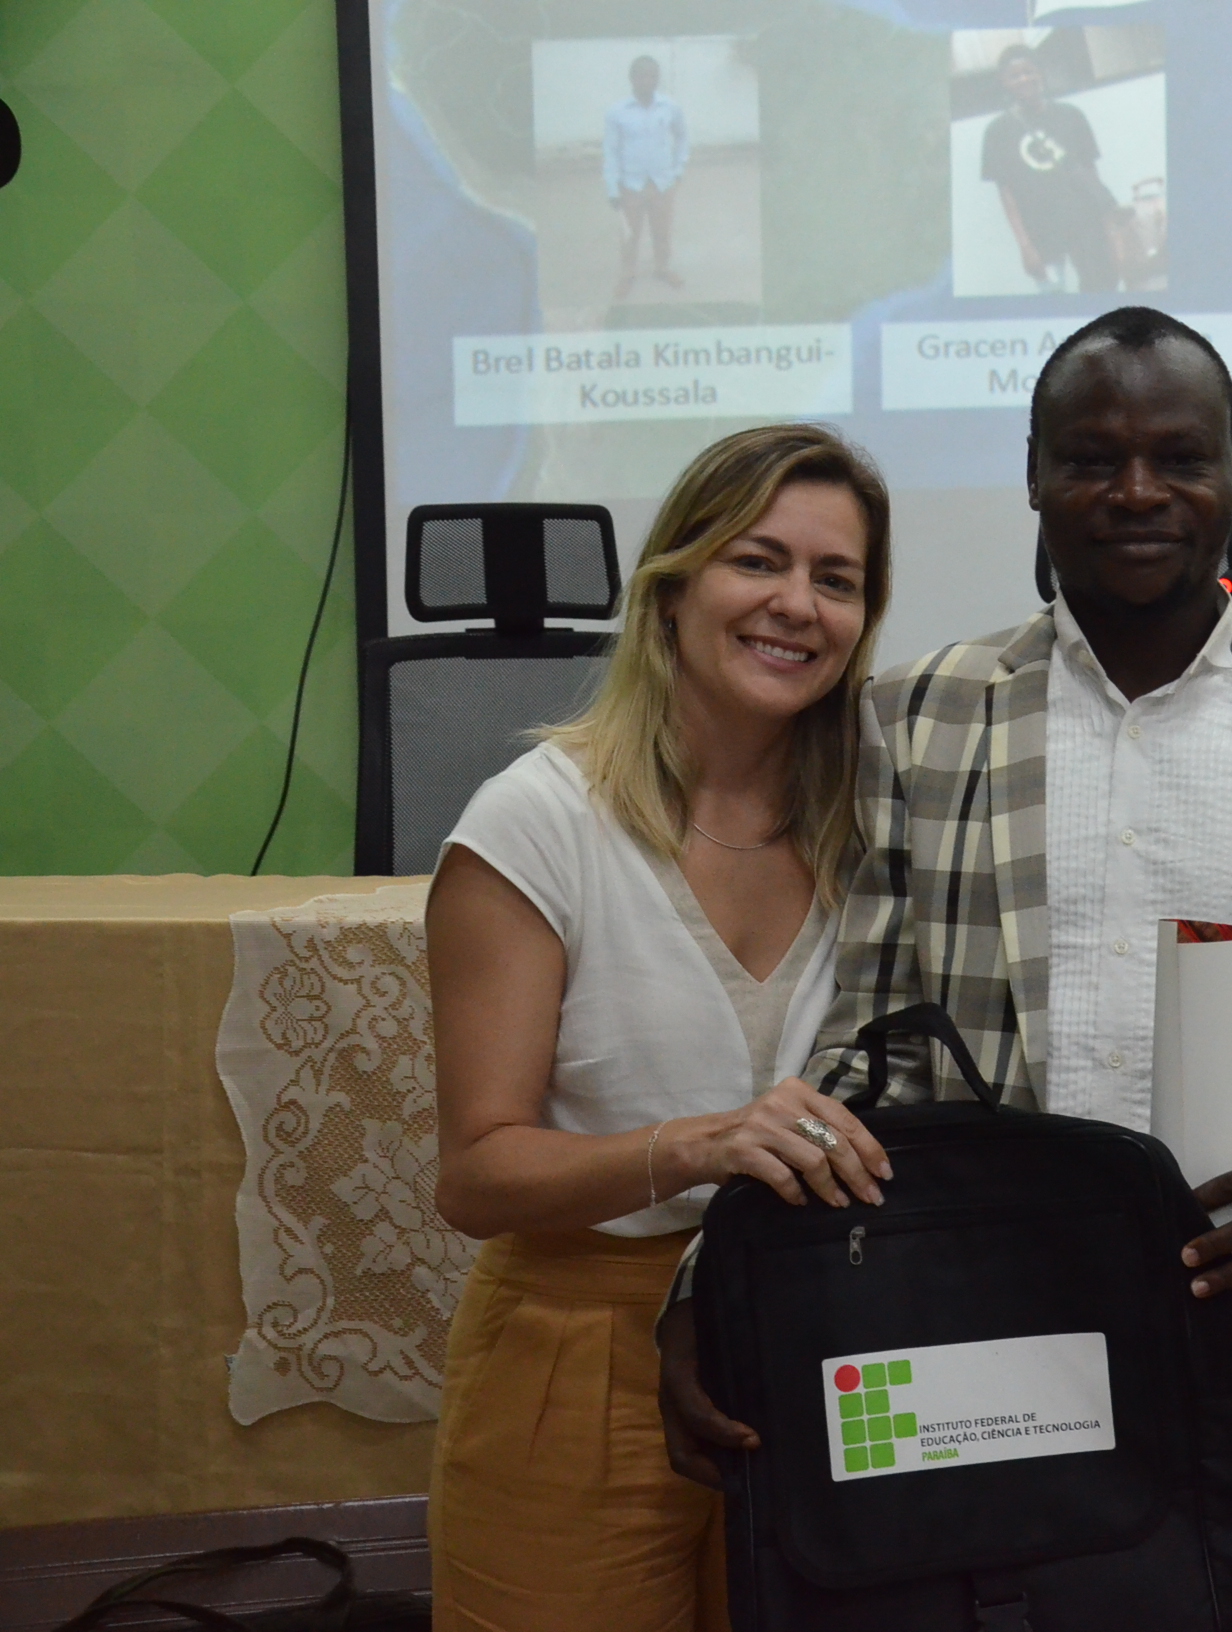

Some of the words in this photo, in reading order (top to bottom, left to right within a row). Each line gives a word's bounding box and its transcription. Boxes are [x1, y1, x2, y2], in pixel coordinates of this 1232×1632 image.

[470, 346, 534, 375] Brel
[544, 343, 641, 373] Batala
[652, 338, 835, 371] Kimbangui-
[916, 333, 1028, 361] Gracen
[579, 380, 718, 409] Koussala
[919, 1419, 972, 1434] INSTITUTO
[974, 1415, 1020, 1428] FEDERAL
[1023, 1413, 1037, 1422] DE
[920, 1431, 979, 1447] EDUCAÇÃO,
[981, 1425, 1022, 1440] CIÊNCIA
[1025, 1426, 1031, 1436] E
[1033, 1419, 1101, 1435] TECNOLOGIA
[922, 1447, 959, 1462] PARAÍBA
